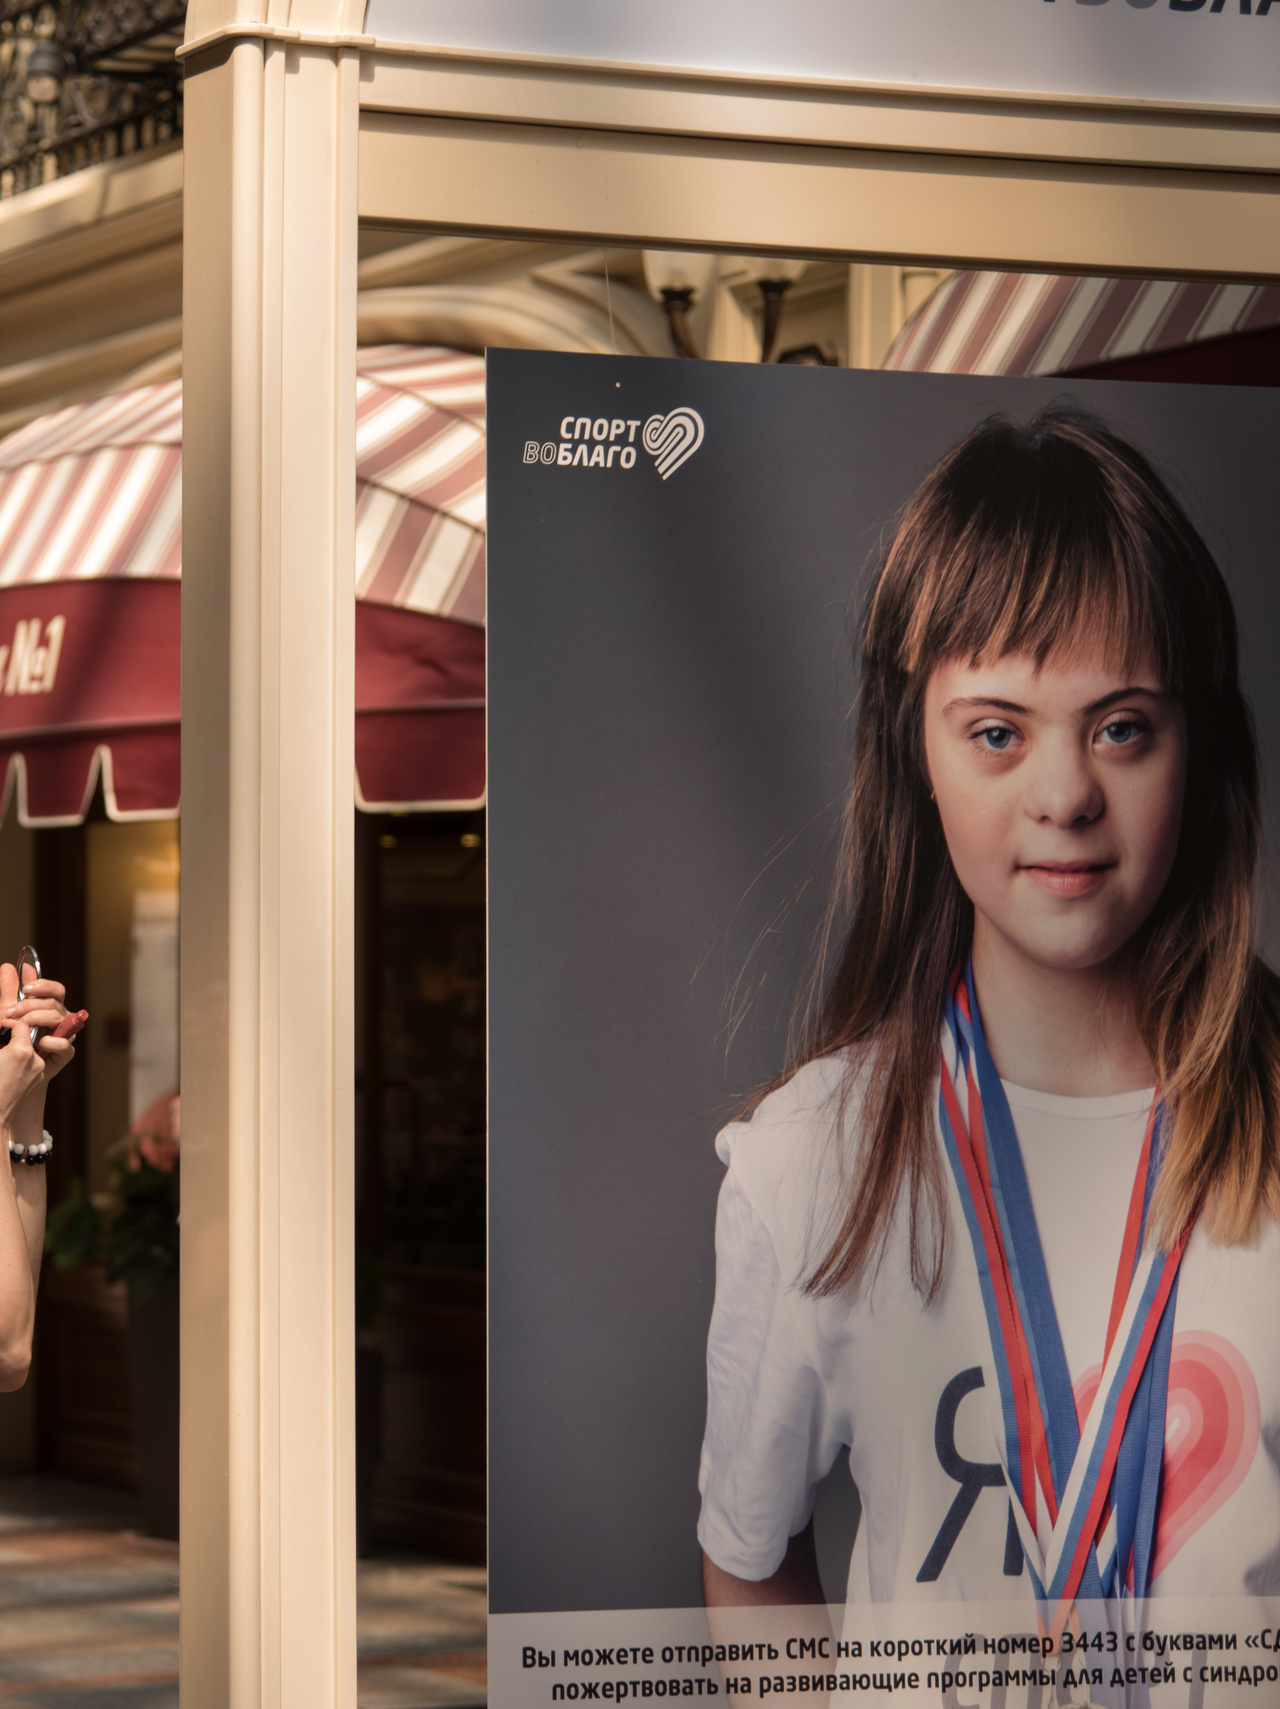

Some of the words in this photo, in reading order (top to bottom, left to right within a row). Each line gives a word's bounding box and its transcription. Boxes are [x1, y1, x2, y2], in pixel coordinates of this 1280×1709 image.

[559, 416, 642, 443] СПОРТ
[521, 1645, 556, 1669] Вы
[563, 1644, 655, 1667] можете
[661, 1642, 780, 1668] отправить
[785, 1637, 830, 1660] СМС
[836, 1640, 863, 1659] на
[870, 1633, 977, 1662] короткий
[983, 1633, 1055, 1659] номер
[1061, 1631, 1119, 1653] 3443
[1125, 1634, 1136, 1653] с
[1142, 1629, 1238, 1657] буквами
[551, 1677, 719, 1704] пожертвовать
[725, 1675, 752, 1695] на
[759, 1669, 920, 1698] развивающие
[926, 1668, 1057, 1693] программы
[1062, 1667, 1104, 1689] для
[1110, 1661, 1177, 1687] детей
[1182, 1665, 1194, 1683] с
